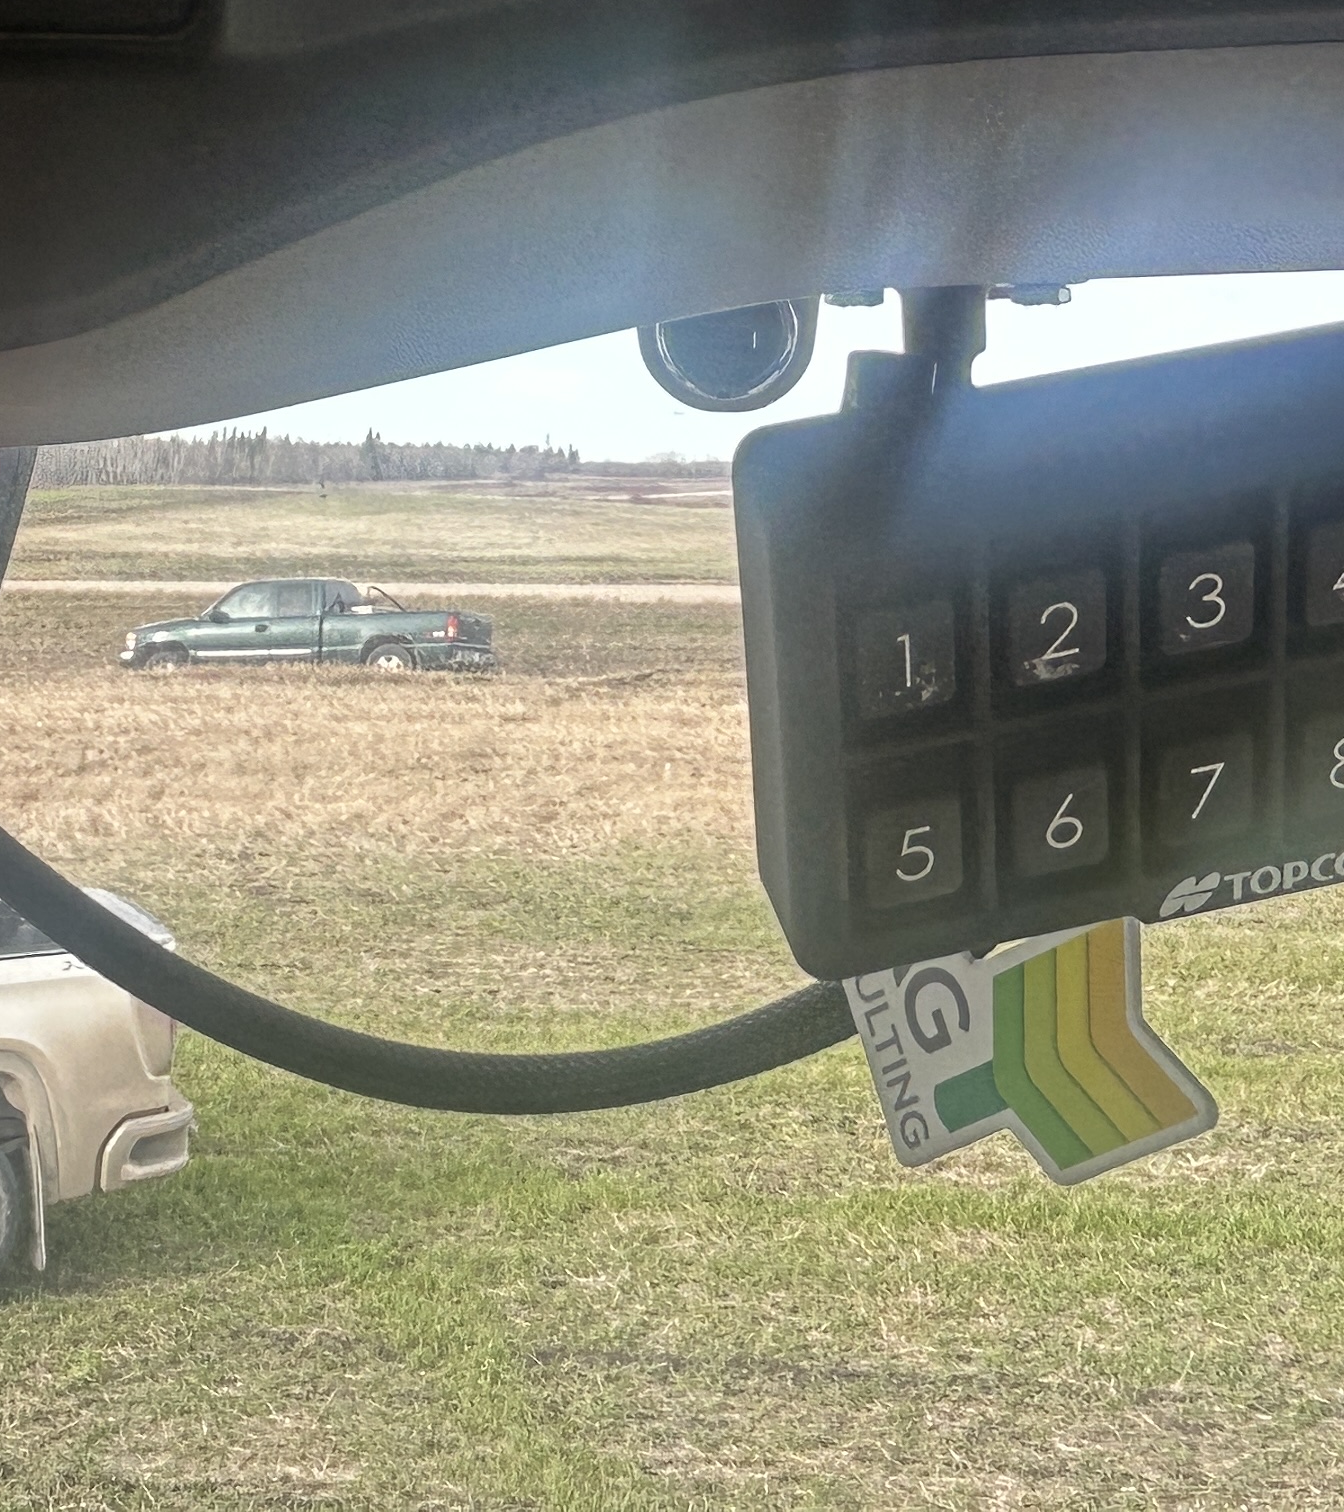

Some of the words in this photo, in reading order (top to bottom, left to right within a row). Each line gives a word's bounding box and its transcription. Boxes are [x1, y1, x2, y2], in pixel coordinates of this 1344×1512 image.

[1186, 573, 1227, 630] 3
[1040, 602, 1081, 662] 2
[897, 633, 912, 689] 1
[1191, 762, 1225, 820] 7
[1045, 793, 1084, 850] 6
[896, 826, 935, 882] 5
